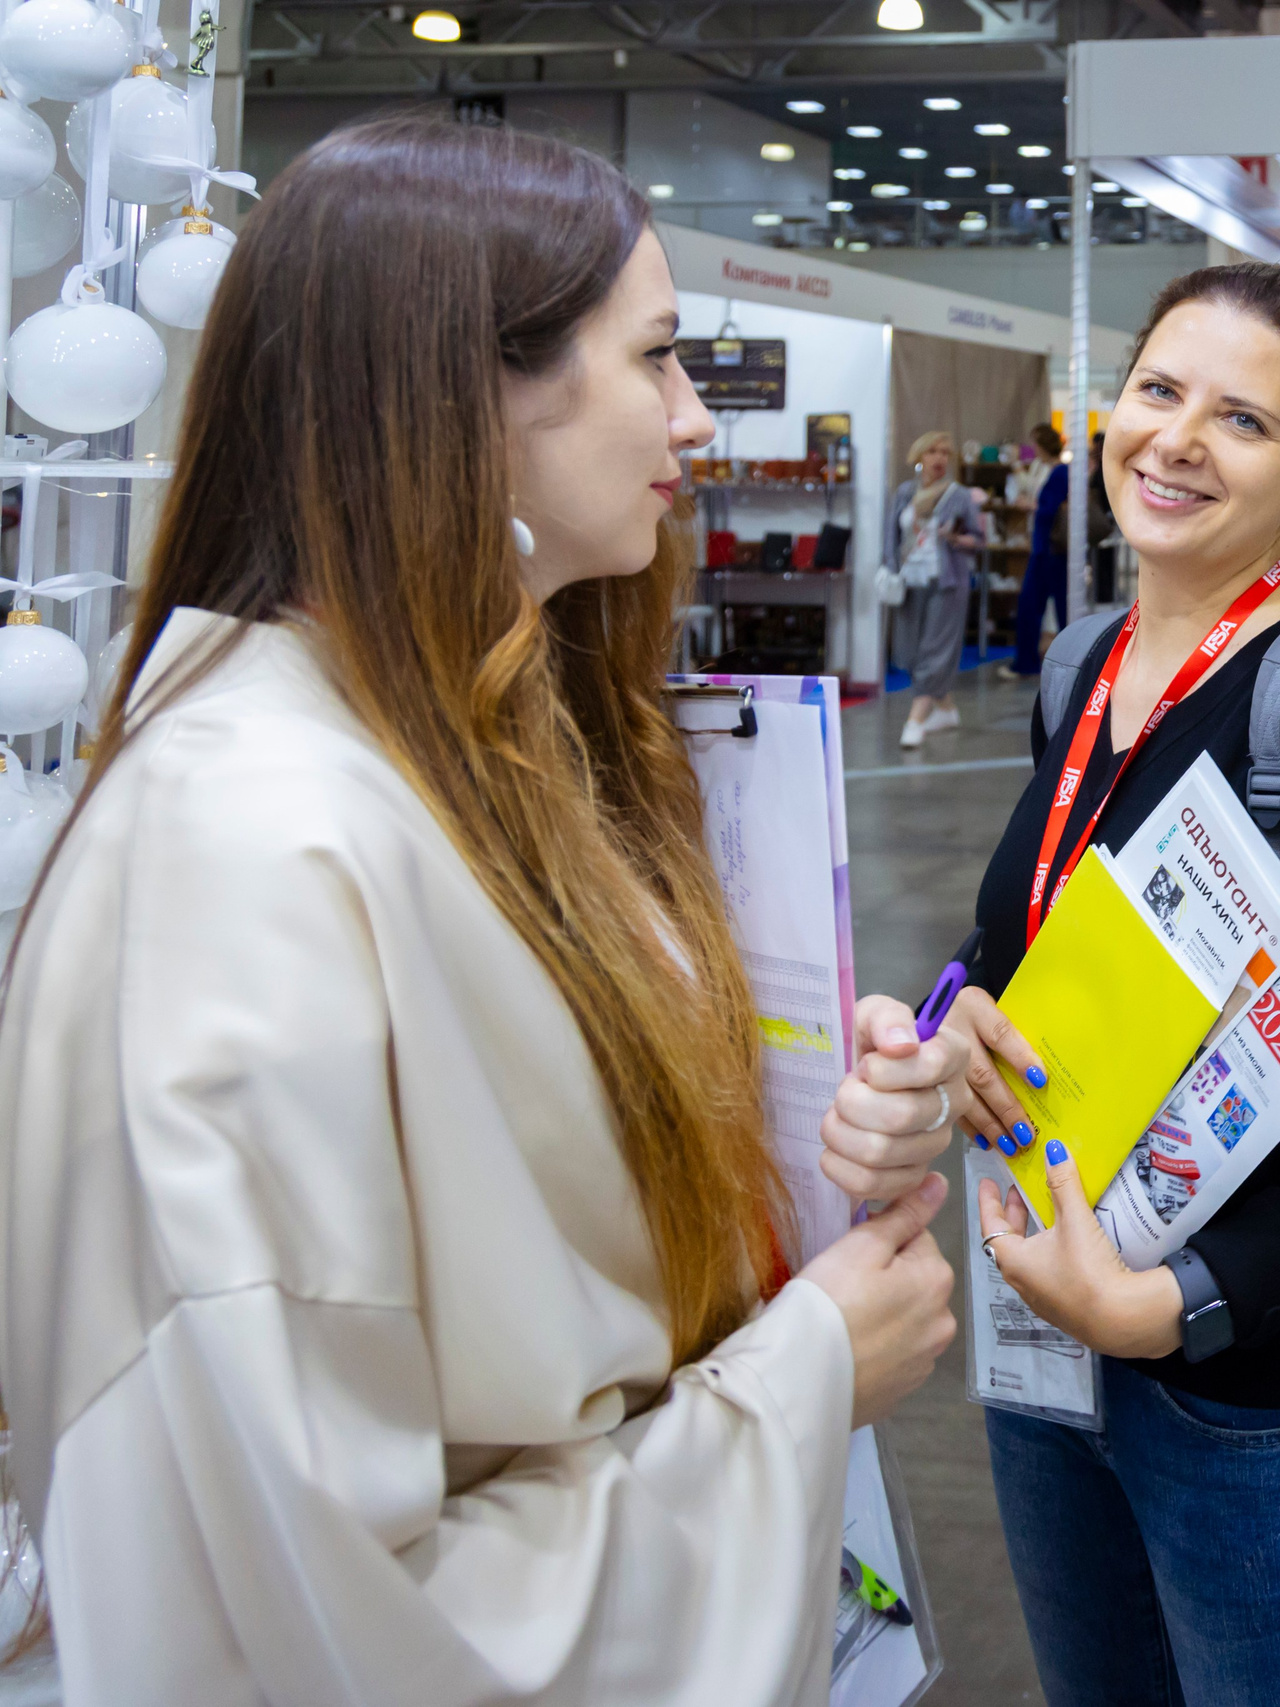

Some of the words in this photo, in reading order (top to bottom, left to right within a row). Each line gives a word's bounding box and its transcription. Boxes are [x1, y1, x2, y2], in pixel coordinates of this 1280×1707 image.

[1199, 620, 1238, 658] IFSA
[1086, 678, 1111, 716] IFSA
[1055, 766, 1081, 808] IFSA
[1031, 862, 1049, 906] IFSA
[1177, 854, 1213, 902] НАШИ
[1211, 898, 1244, 945] ХИТЫ
[1195, 928, 1226, 970] Mozabrick
[1117, 1168, 1161, 1242] ОНЕПРОНИЦАЕМЫЕ
